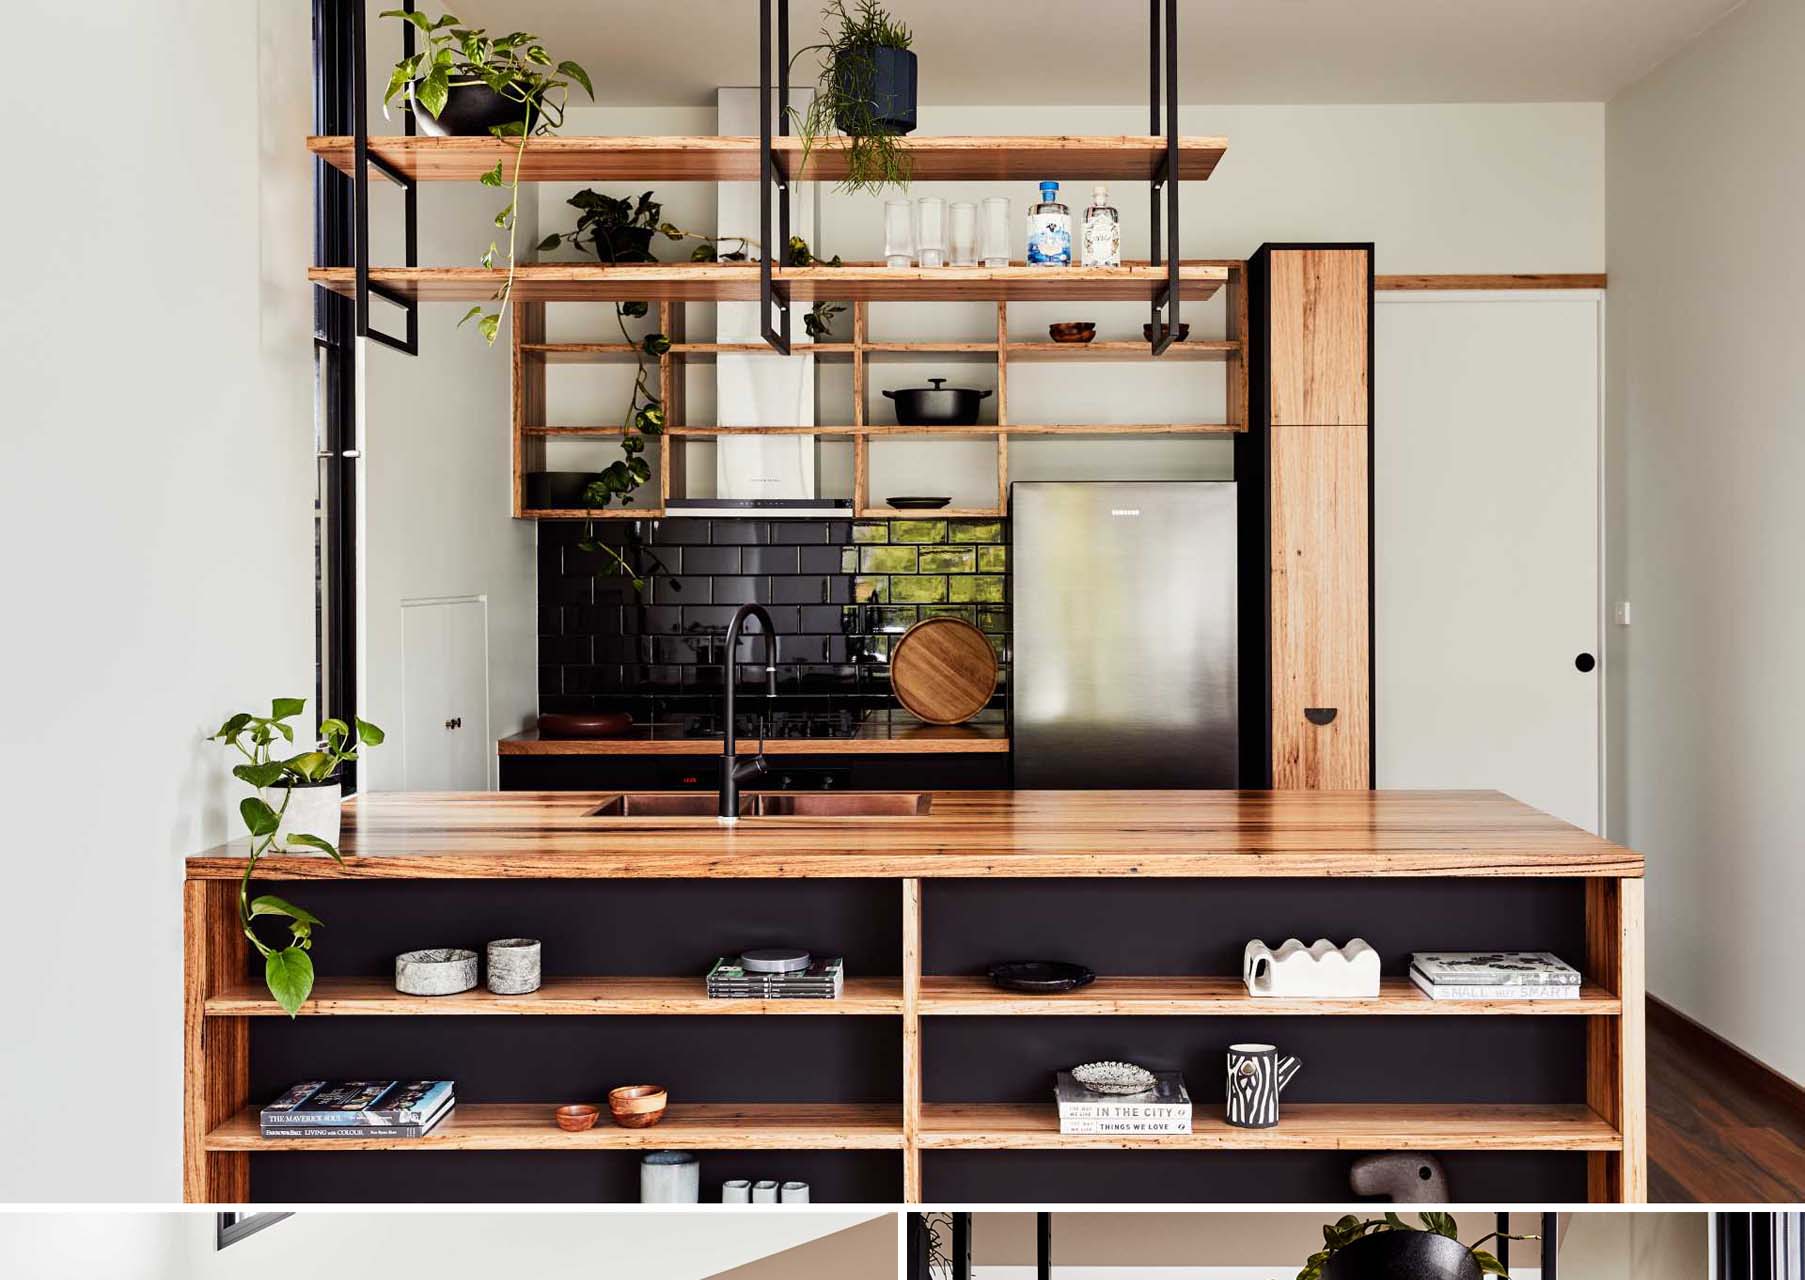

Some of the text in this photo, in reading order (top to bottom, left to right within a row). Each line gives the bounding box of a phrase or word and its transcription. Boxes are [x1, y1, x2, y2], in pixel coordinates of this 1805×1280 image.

[1096, 1107, 1173, 1117] IN THE CITY
[1100, 1123, 1131, 1131] THINGS
[1133, 1123, 1146, 1131] WE
[1148, 1123, 1169, 1131] LOVE
